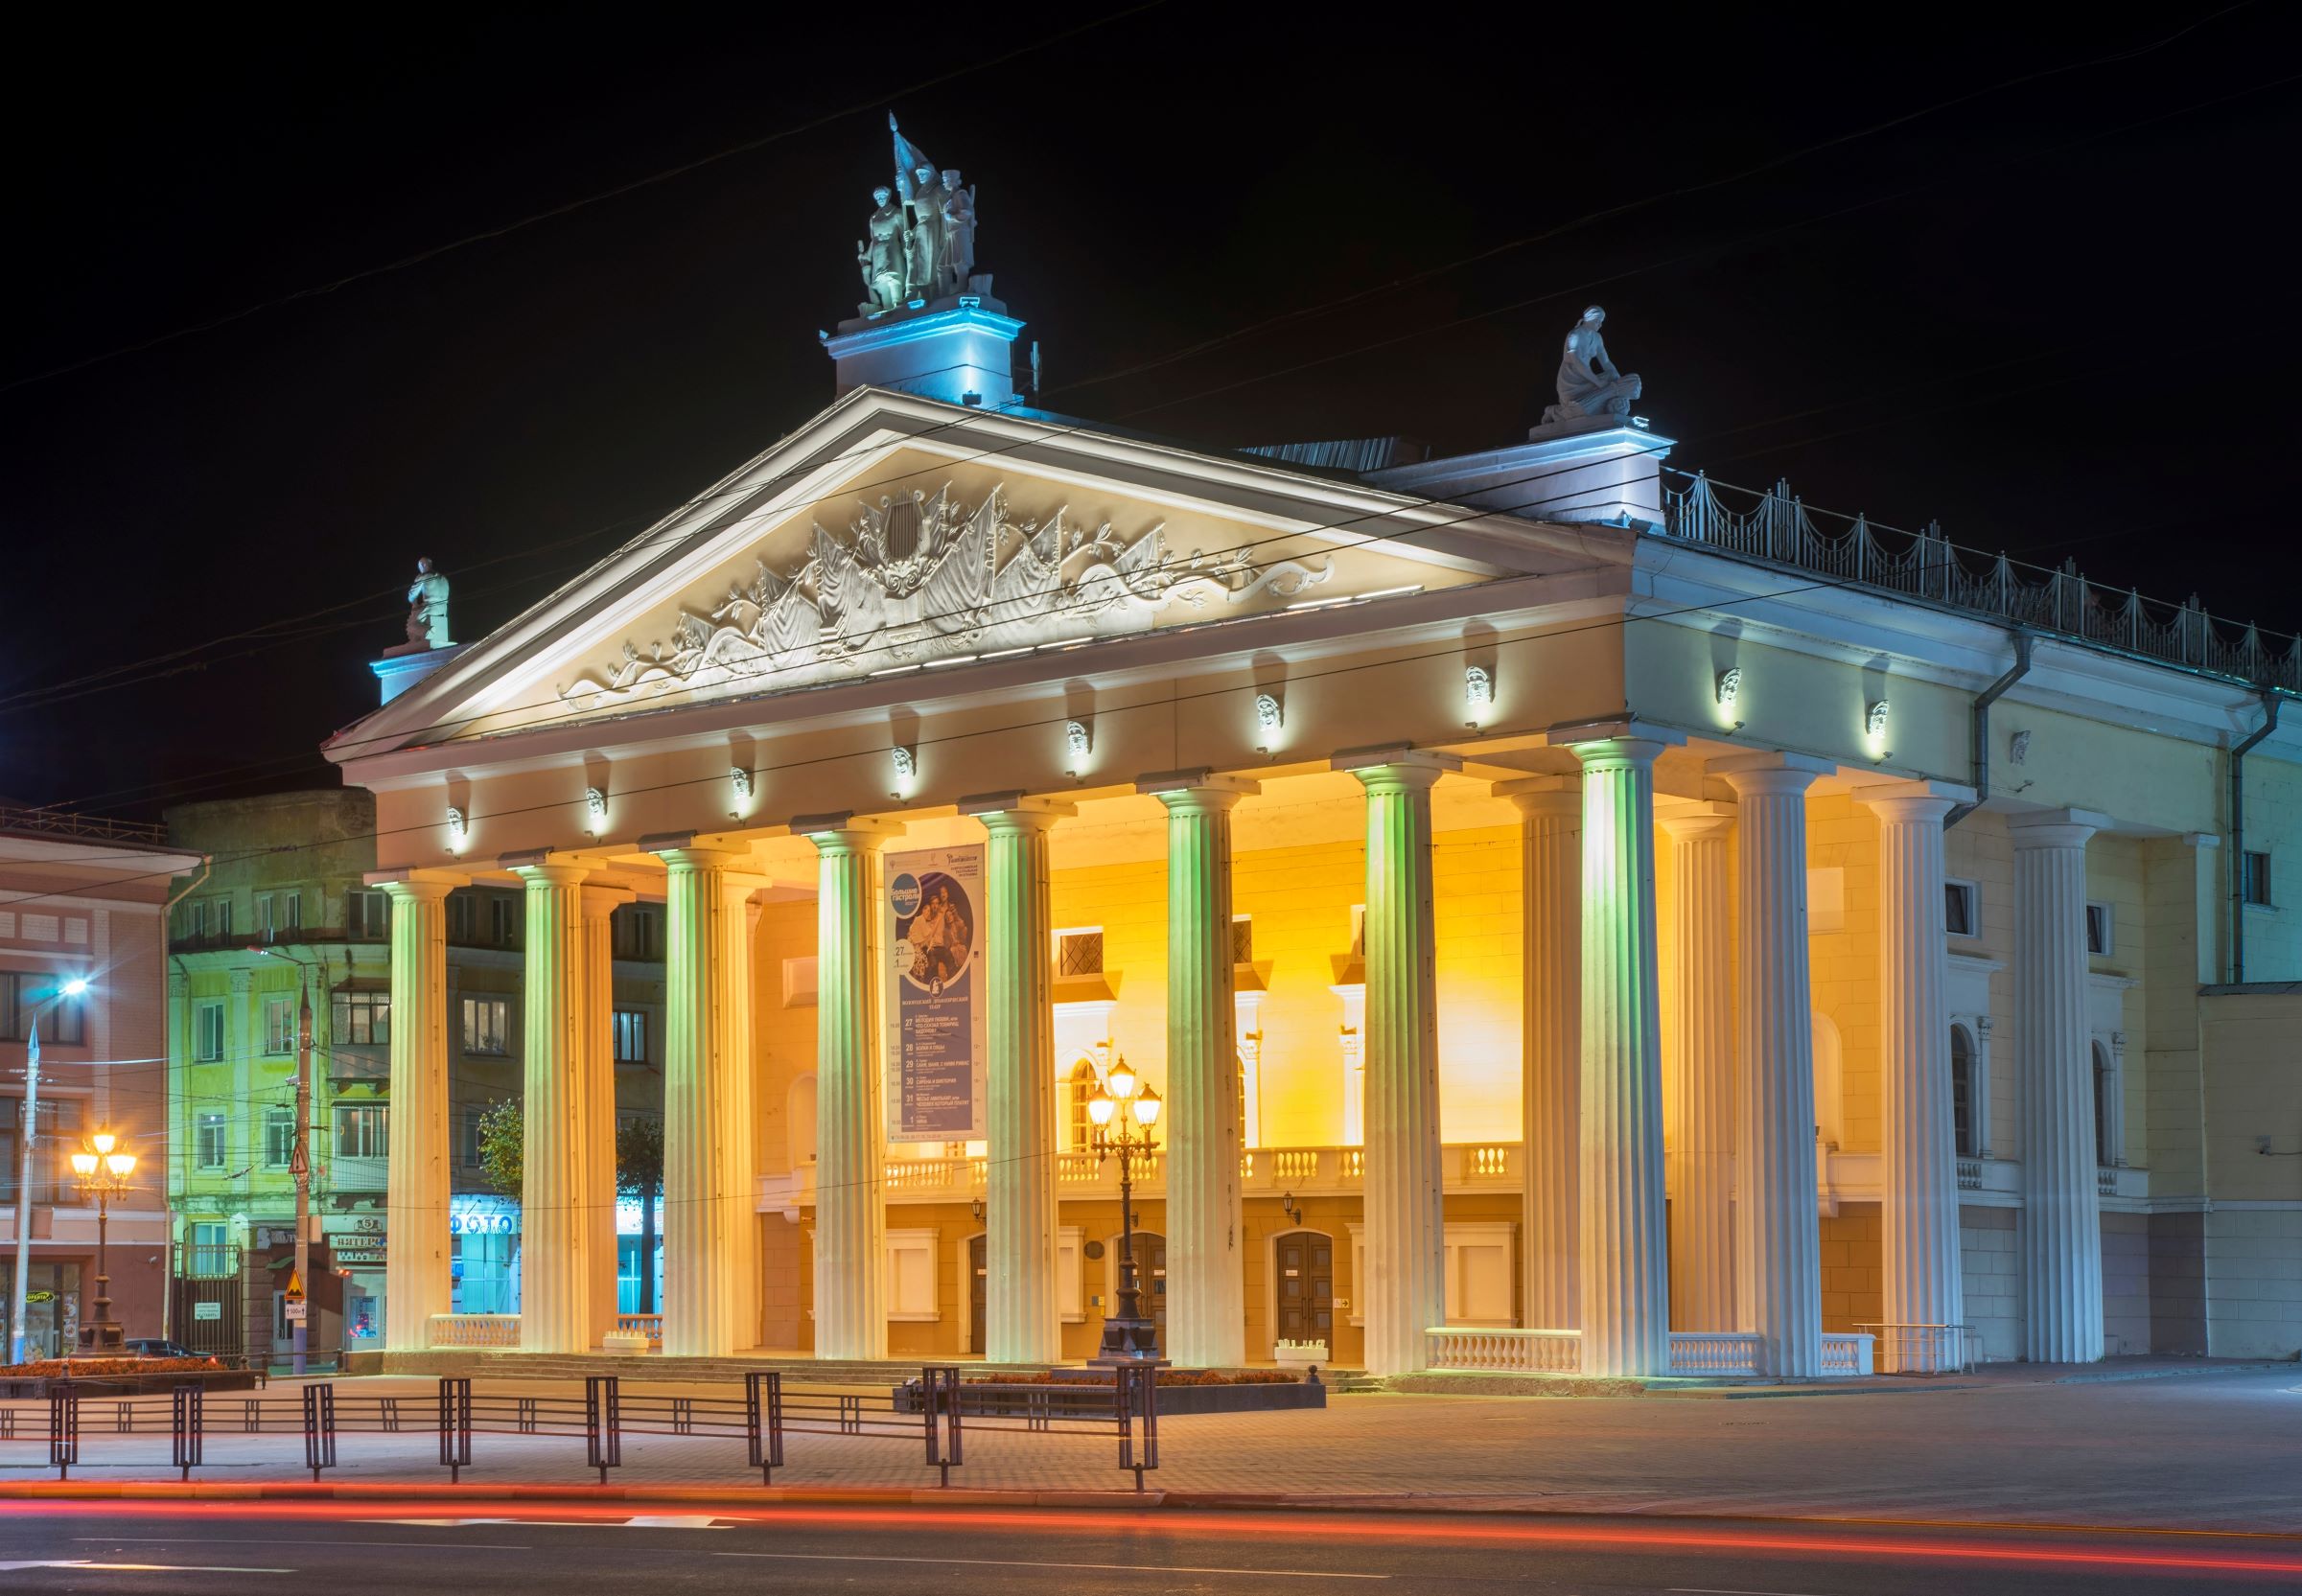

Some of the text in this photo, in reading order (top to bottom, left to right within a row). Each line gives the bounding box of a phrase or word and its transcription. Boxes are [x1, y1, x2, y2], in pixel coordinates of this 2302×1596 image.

[895, 946, 904, 956] 27
[905, 1018, 913, 1027] 27
[451, 1214, 512, 1235] ФОТО
